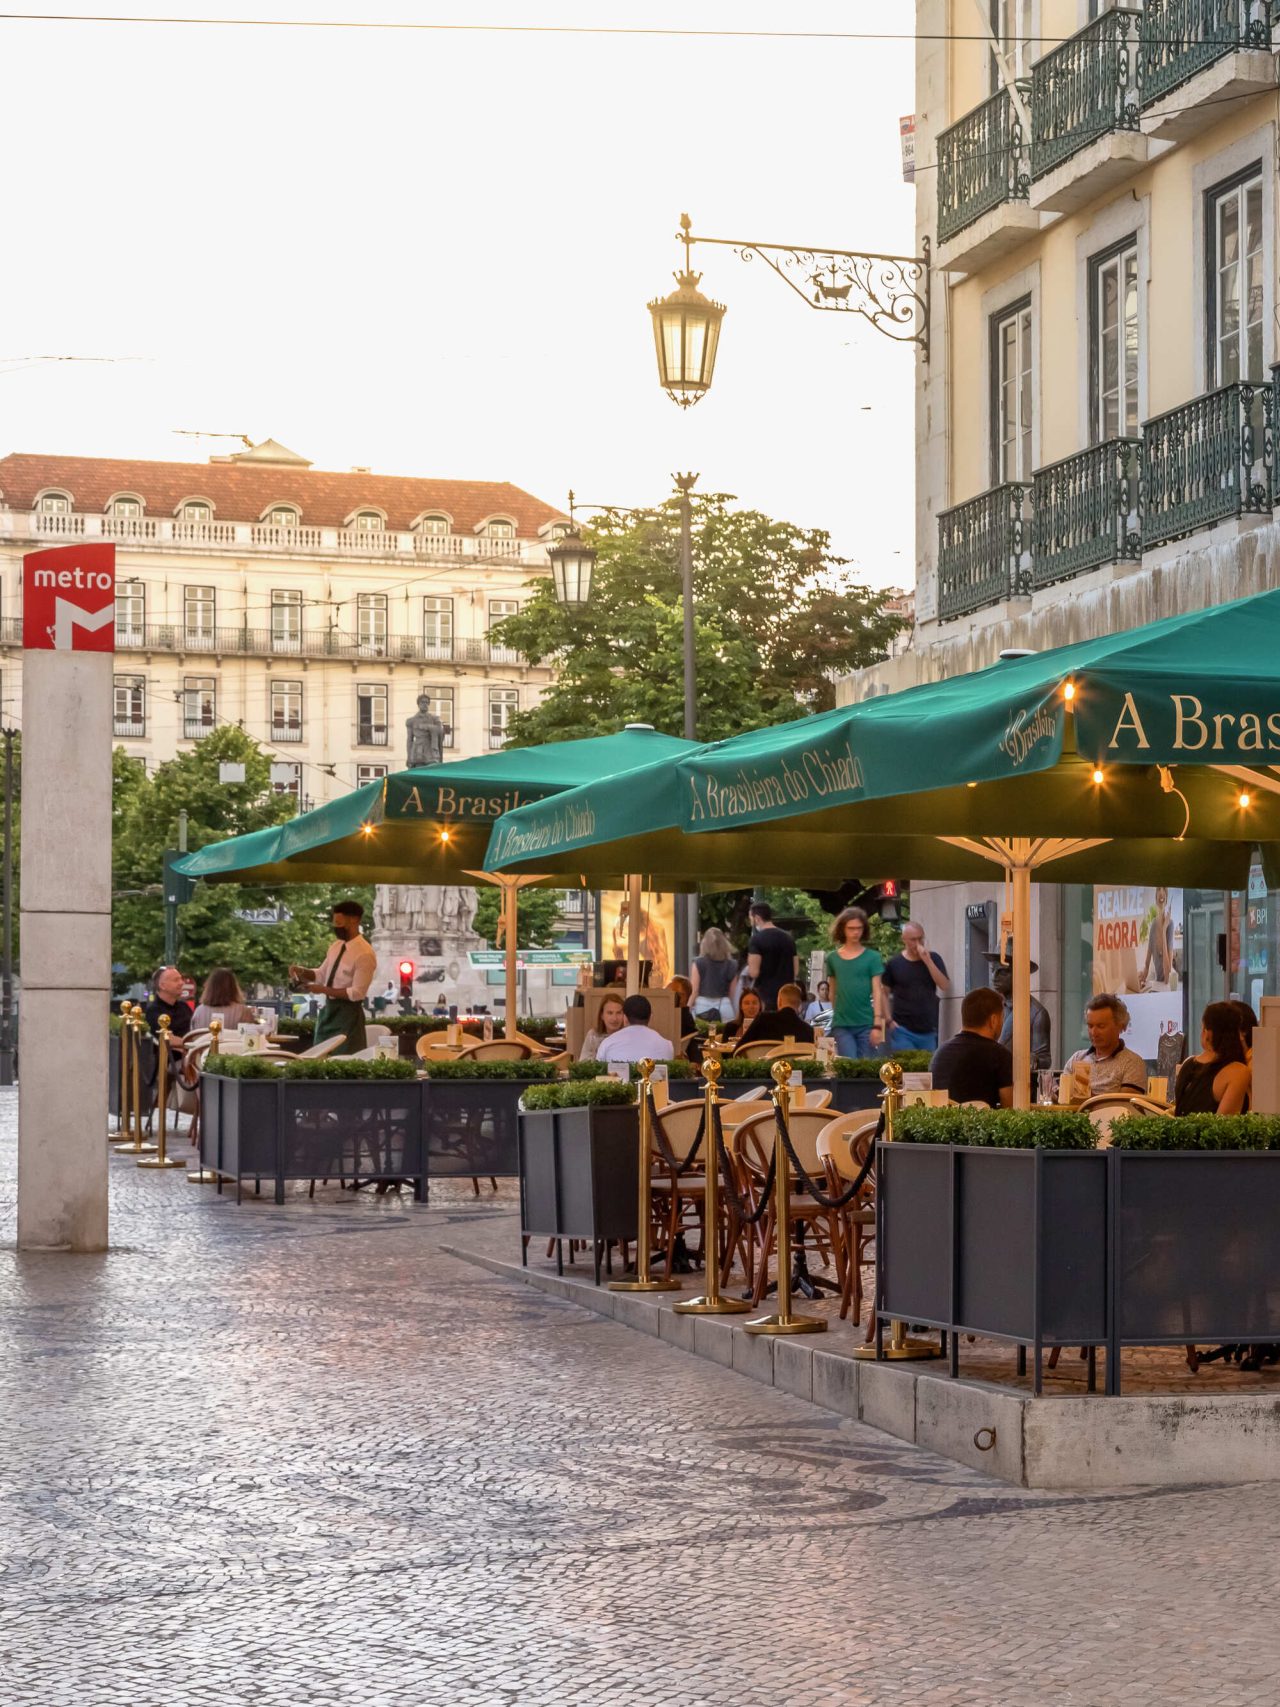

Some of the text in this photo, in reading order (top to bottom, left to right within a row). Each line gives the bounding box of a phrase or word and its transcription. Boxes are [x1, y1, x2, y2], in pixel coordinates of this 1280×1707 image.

[34, 567, 112, 590] metro
[1108, 692, 1150, 748] A
[690, 742, 865, 821] A Brasileira do Chiado
[401, 786, 424, 813] A
[1098, 887, 1145, 920] REALIZE
[1097, 920, 1138, 951] AGORA
